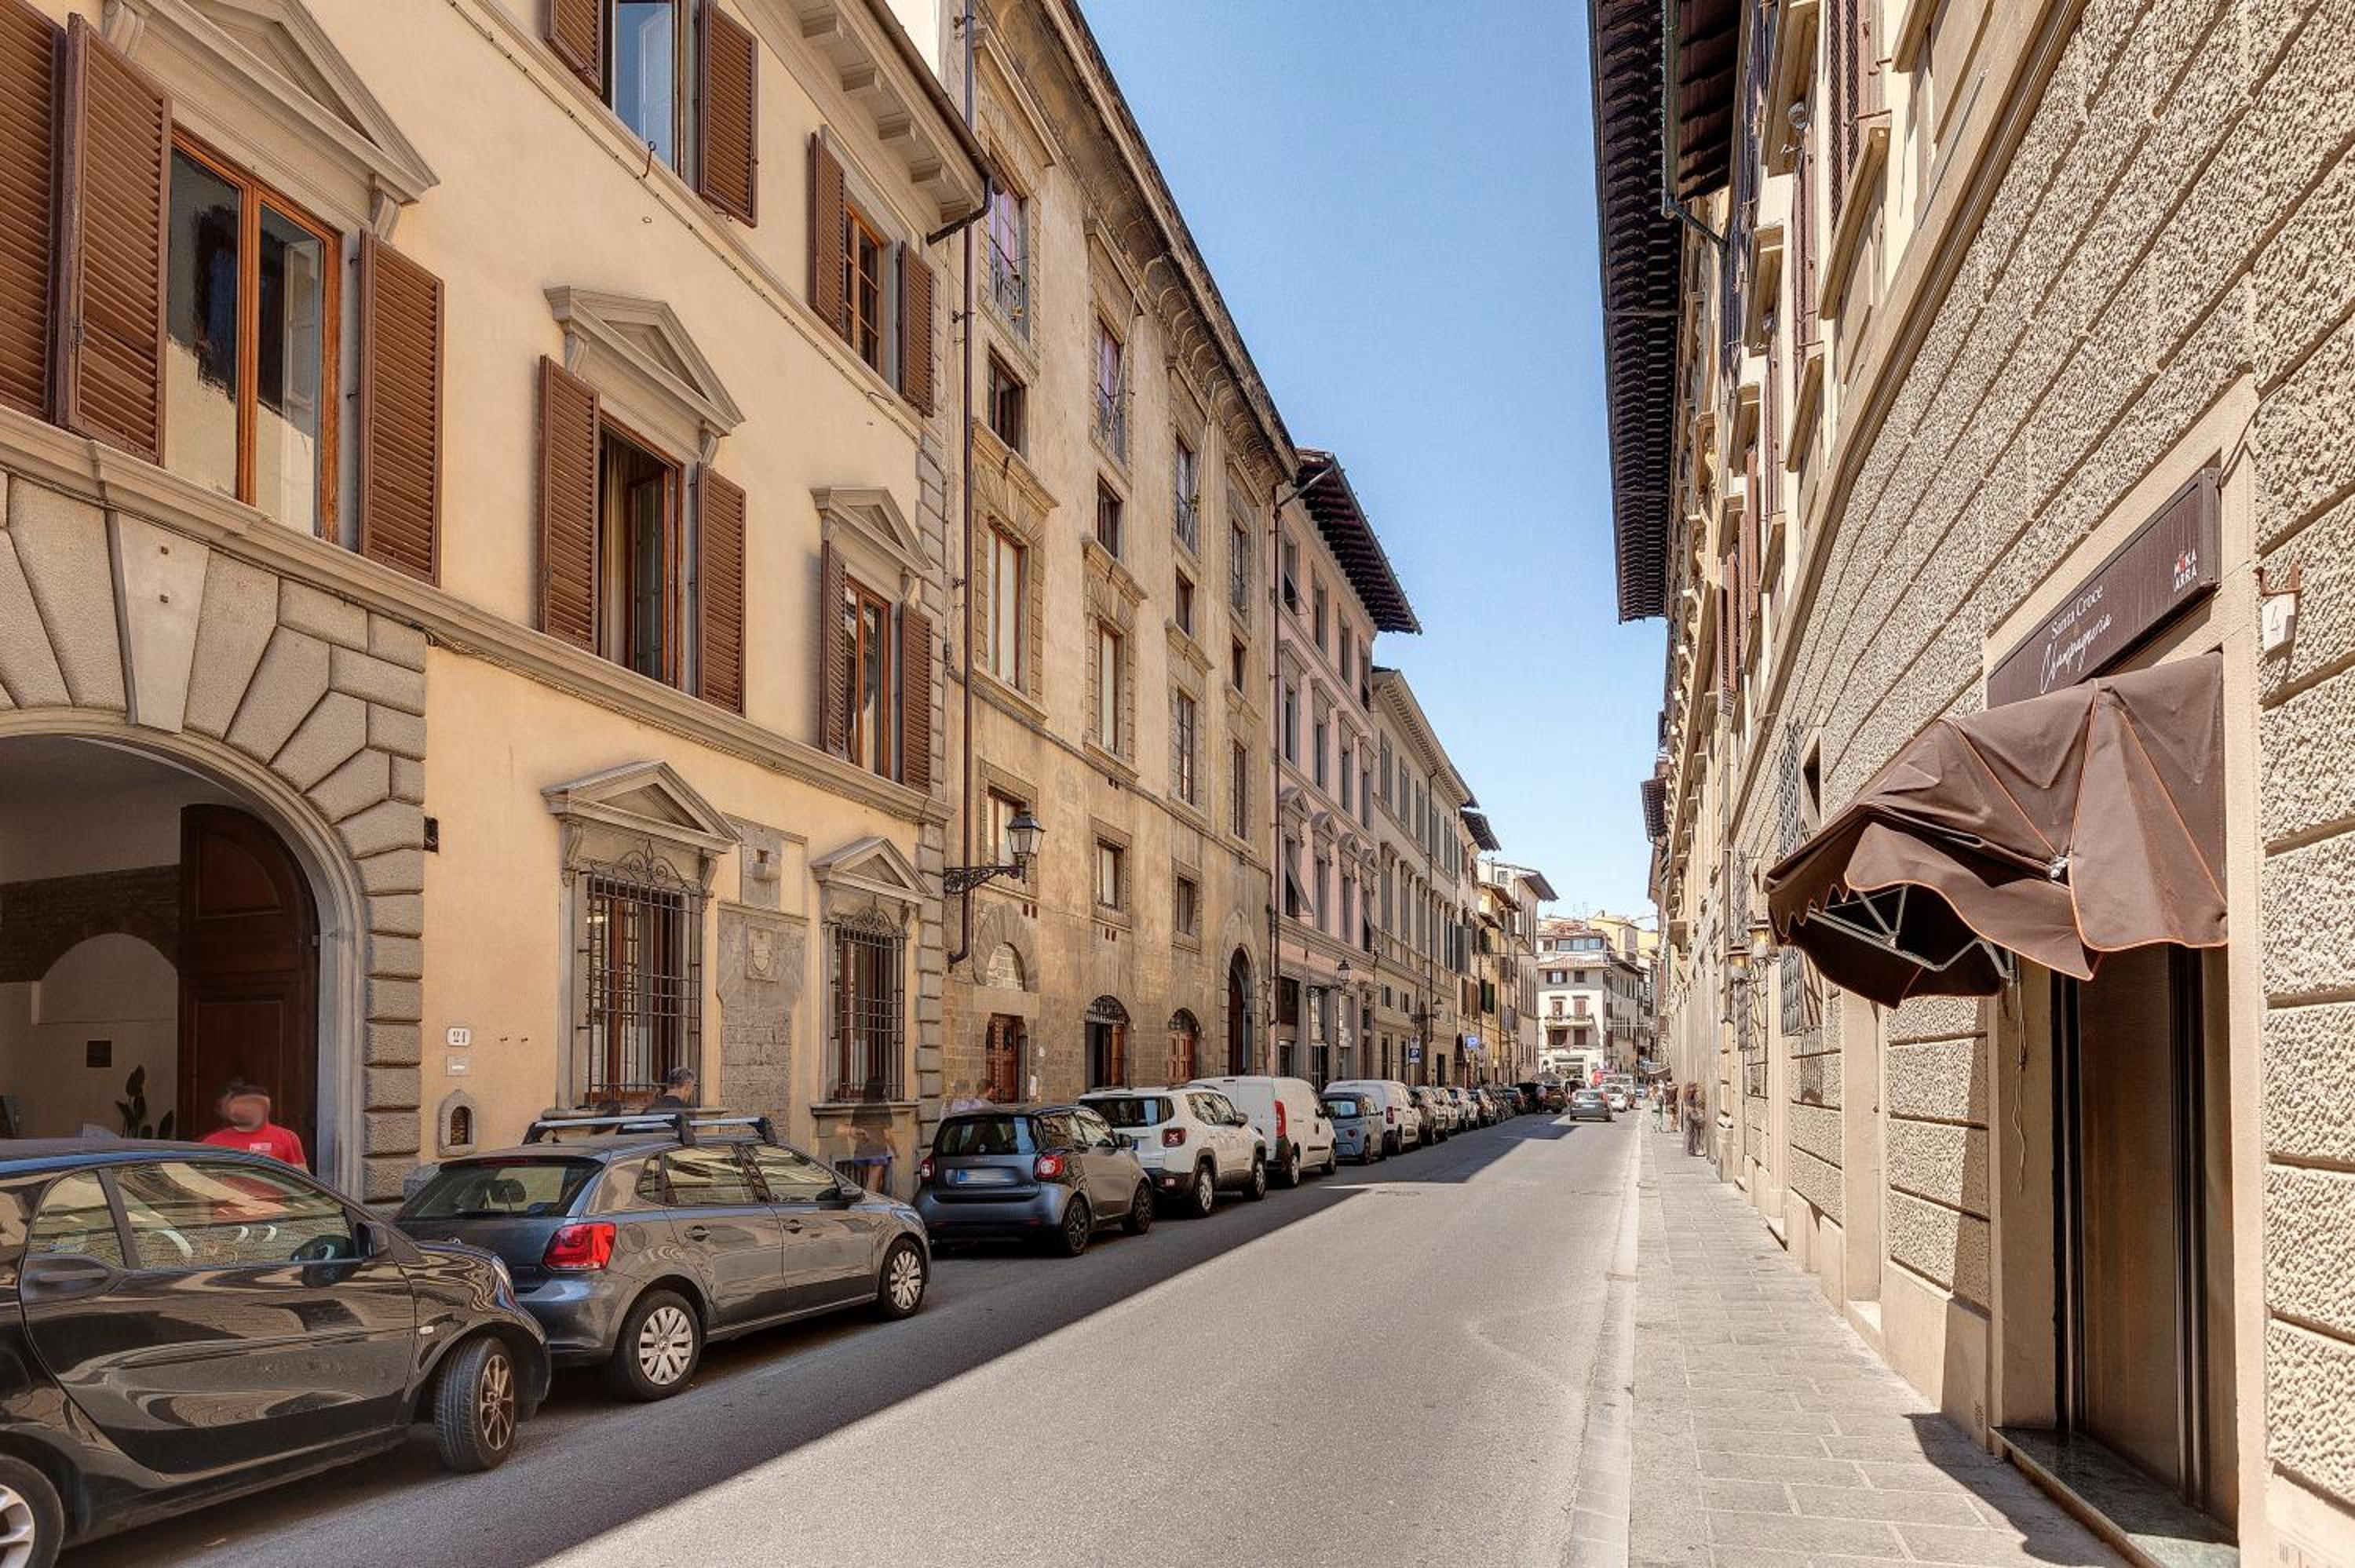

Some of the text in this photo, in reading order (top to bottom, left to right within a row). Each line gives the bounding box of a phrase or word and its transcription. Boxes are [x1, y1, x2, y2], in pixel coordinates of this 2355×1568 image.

[2051, 584, 2103, 640] Santa Croce
[453, 1030, 466, 1043] 21
